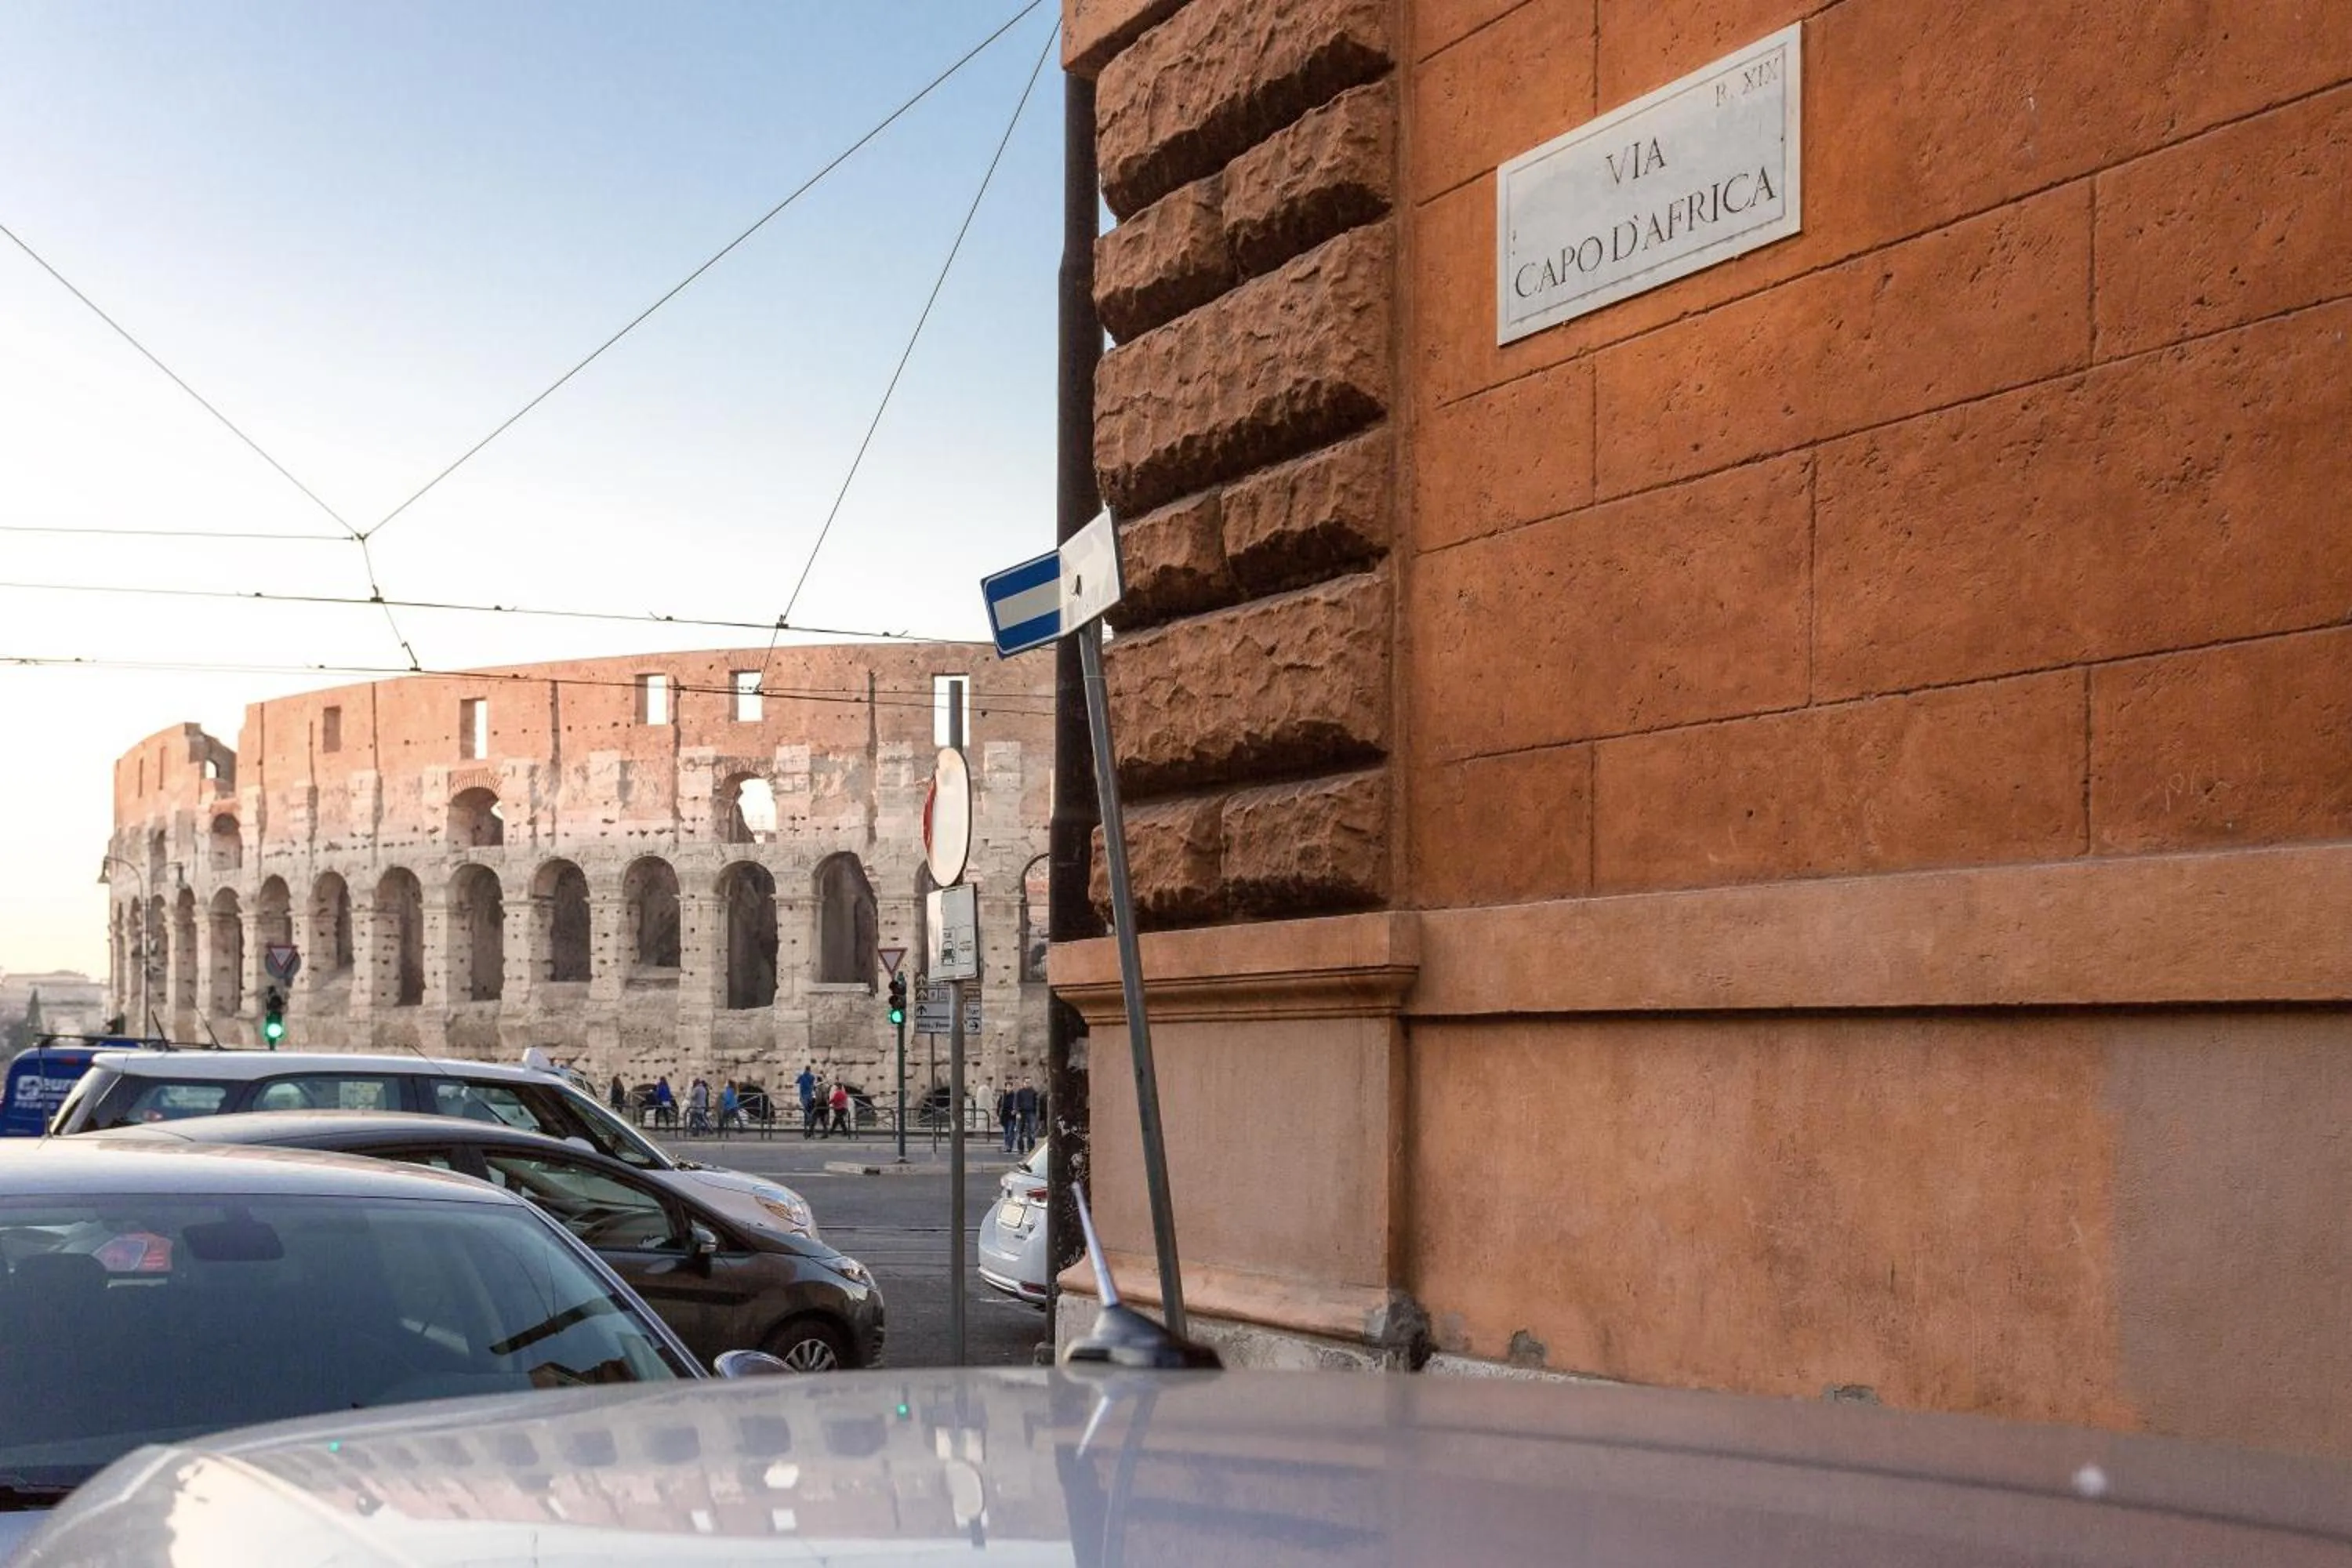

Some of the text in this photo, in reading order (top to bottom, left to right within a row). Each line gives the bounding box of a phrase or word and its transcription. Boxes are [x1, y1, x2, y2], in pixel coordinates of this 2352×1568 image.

[1605, 136, 1667, 184] VIA
[1515, 165, 1777, 299] CAPO D'AFRICA
